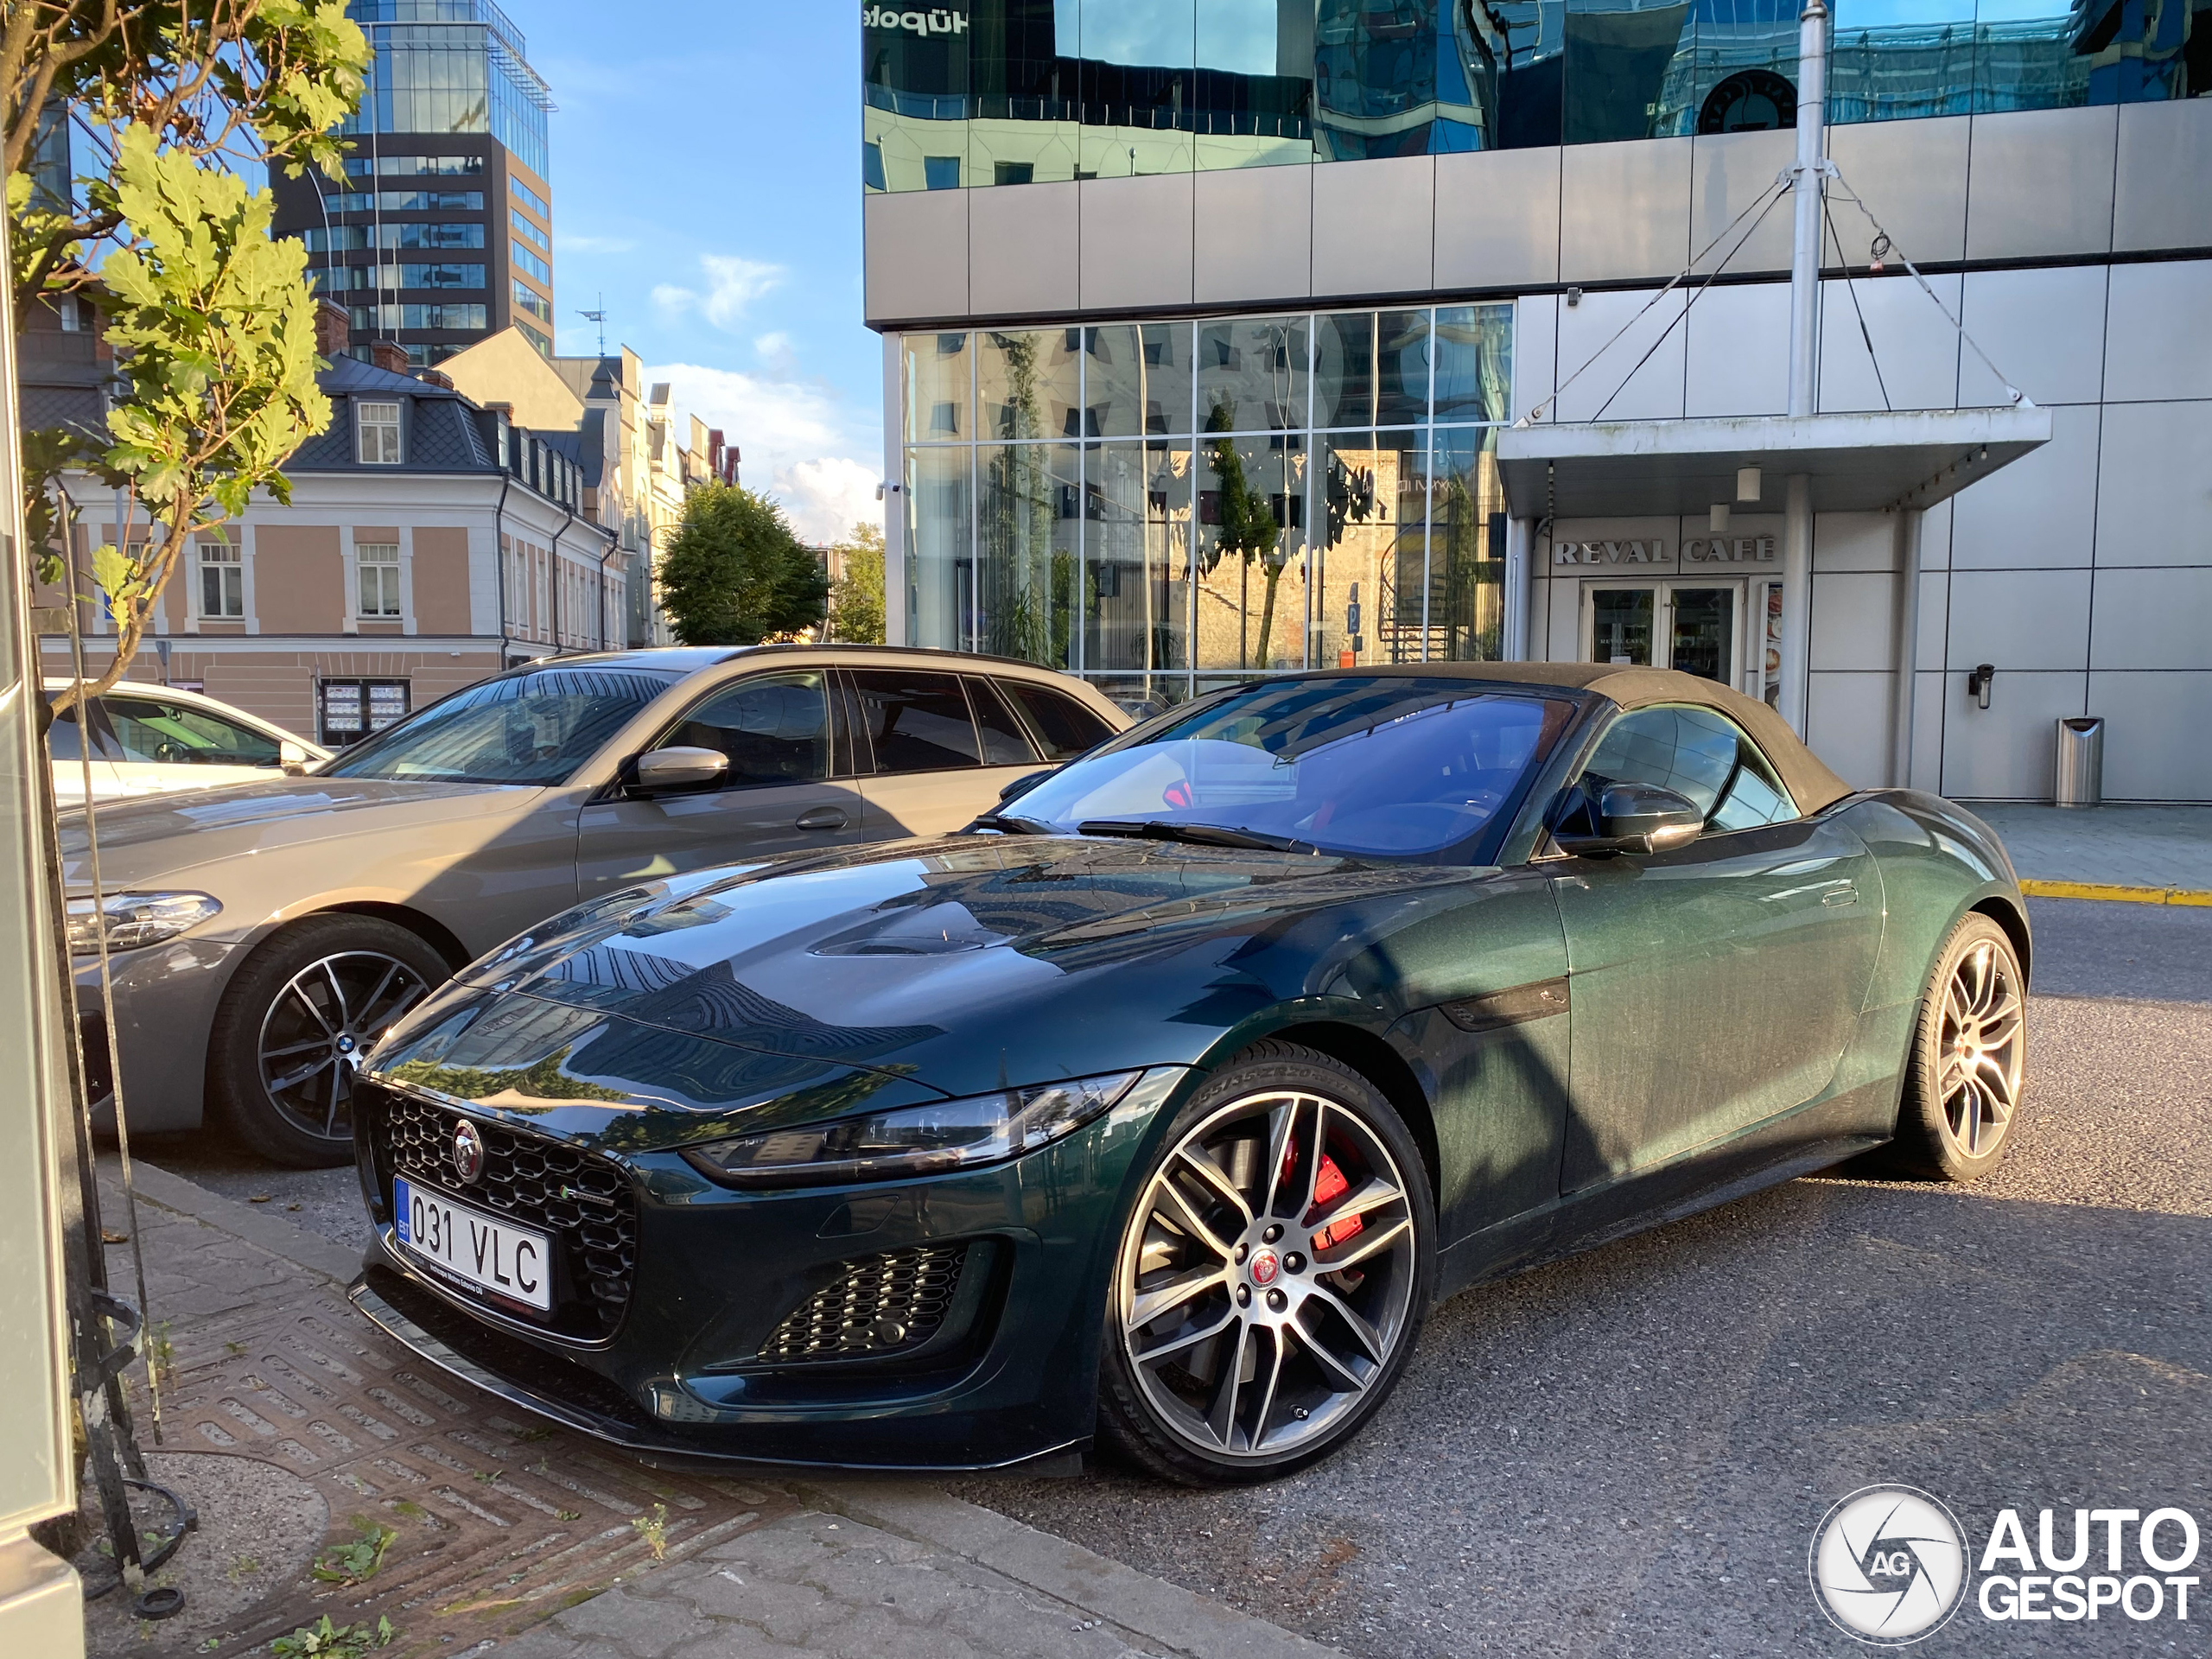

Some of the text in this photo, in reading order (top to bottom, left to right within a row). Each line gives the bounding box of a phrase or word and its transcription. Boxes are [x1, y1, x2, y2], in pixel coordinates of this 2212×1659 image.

[1554, 539, 1670, 564] REVAL
[398, 1219, 410, 1236] EST
[413, 1195, 537, 1294] 031 VLC
